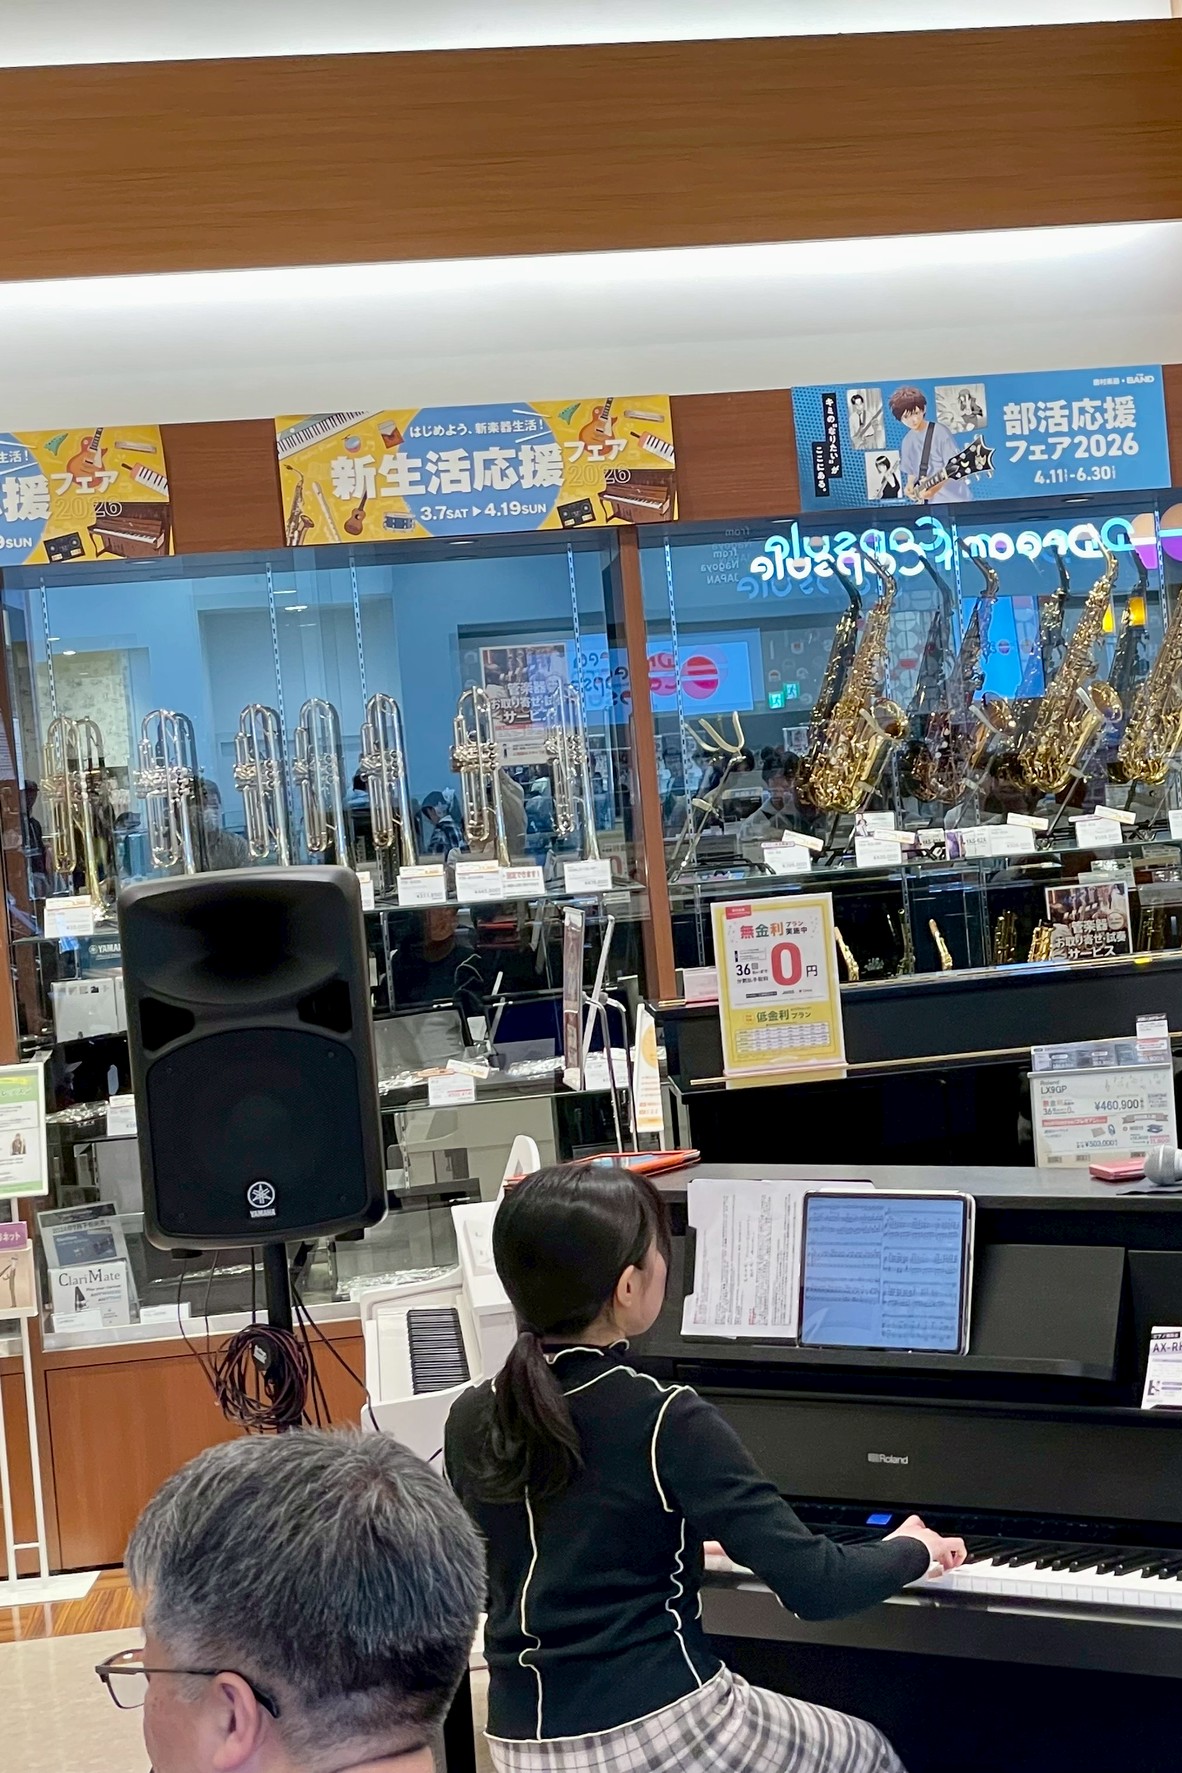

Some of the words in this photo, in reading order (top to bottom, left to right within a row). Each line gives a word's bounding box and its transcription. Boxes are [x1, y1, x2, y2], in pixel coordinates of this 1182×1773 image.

[1003, 395, 1137, 436] 部活応援
[564, 439, 628, 463] フェア
[1005, 432, 1140, 463] フェア2026
[330, 443, 566, 501] 新生活応援
[568, 466, 631, 486] 2026
[51, 471, 119, 496] フェア
[55, 496, 122, 520] 2026
[484, 503, 547, 517] 4.19SUN
[740, 922, 784, 939] 無金利
[1068, 945, 1116, 959] サービス
[735, 963, 751, 976] 36
[771, 942, 802, 986] 0
[806, 965, 818, 977] 円
[757, 1009, 790, 1022] 低金利
[59, 1269, 121, 1287] ClariMate
[879, 1453, 908, 1465] Roland
